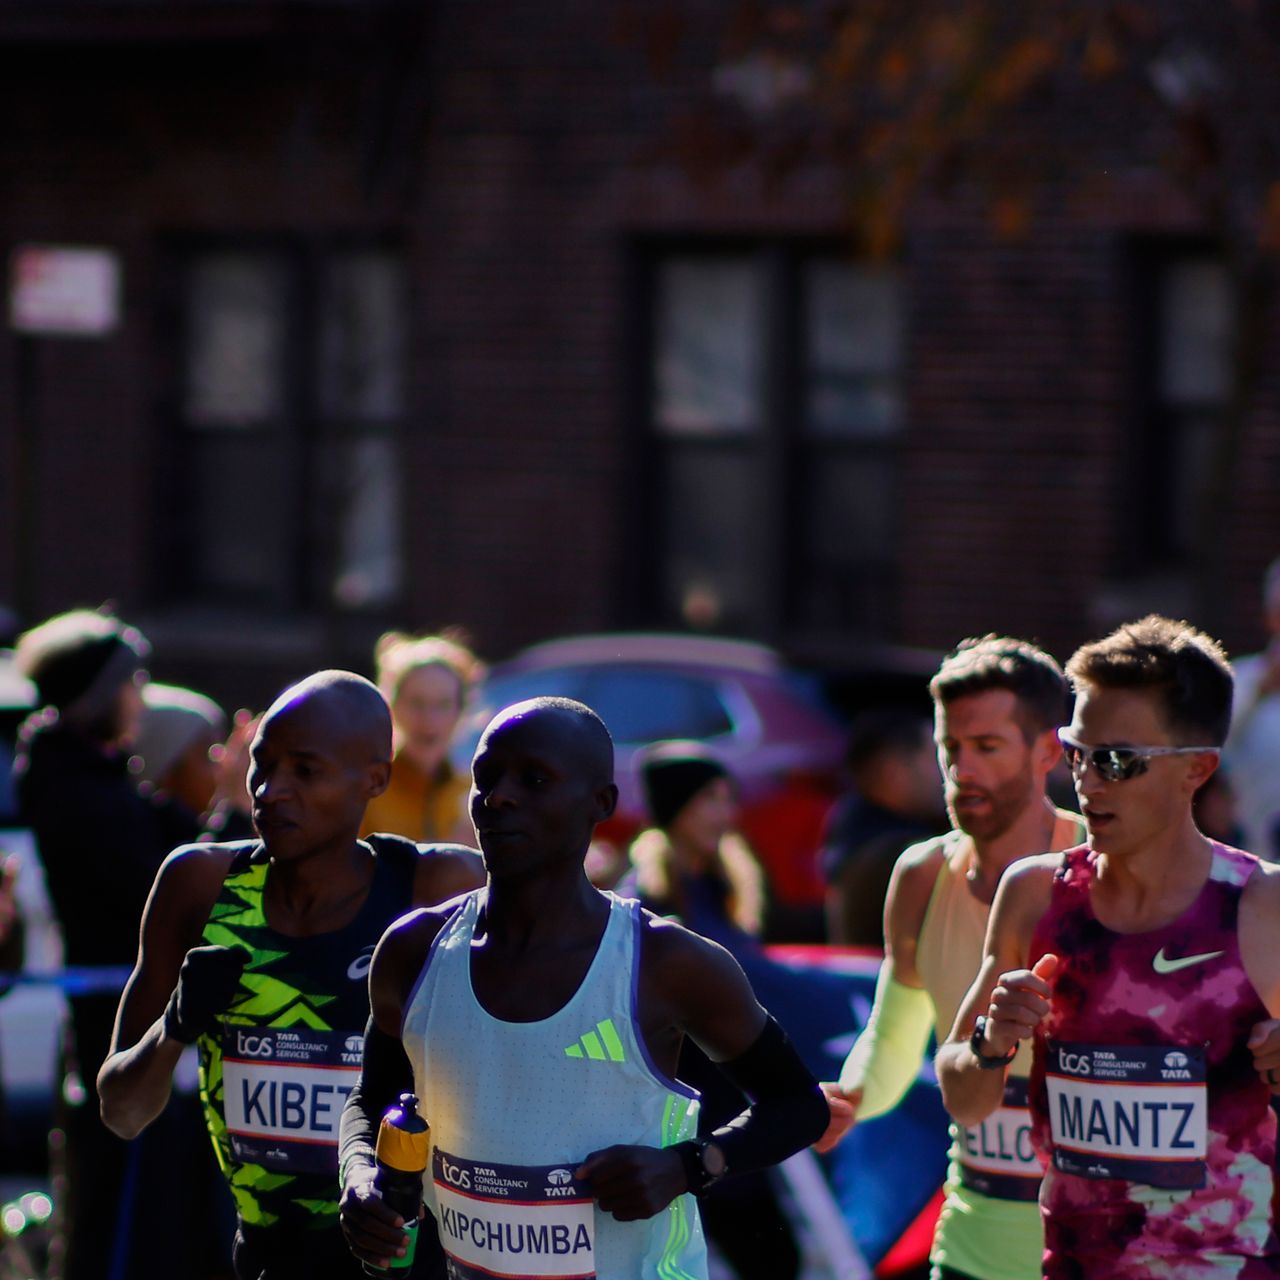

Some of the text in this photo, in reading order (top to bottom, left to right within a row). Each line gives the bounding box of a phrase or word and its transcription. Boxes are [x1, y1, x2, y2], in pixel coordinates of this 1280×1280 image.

[276, 1033, 300, 1041] TATA
[237, 1030, 273, 1056] tcs
[276, 1042, 328, 1052] CONSULTANCY
[276, 1050, 310, 1059] SERVICES
[341, 1053, 362, 1062] TAT
[1093, 1051, 1116, 1060] TATA
[1059, 1047, 1090, 1074] tcs
[1093, 1060, 1147, 1070] CONSULTANCY
[1160, 1069, 1192, 1080] TATA
[1058, 1091, 1195, 1149] MANTZ
[442, 1156, 471, 1189] tcs
[473, 1166, 497, 1177] TATA
[473, 1176, 529, 1189] CONSULTANCY
[475, 1184, 509, 1196] SERVICES
[544, 1186, 577, 1197] TATA
[440, 1203, 592, 1255] KIPCHUMBA
